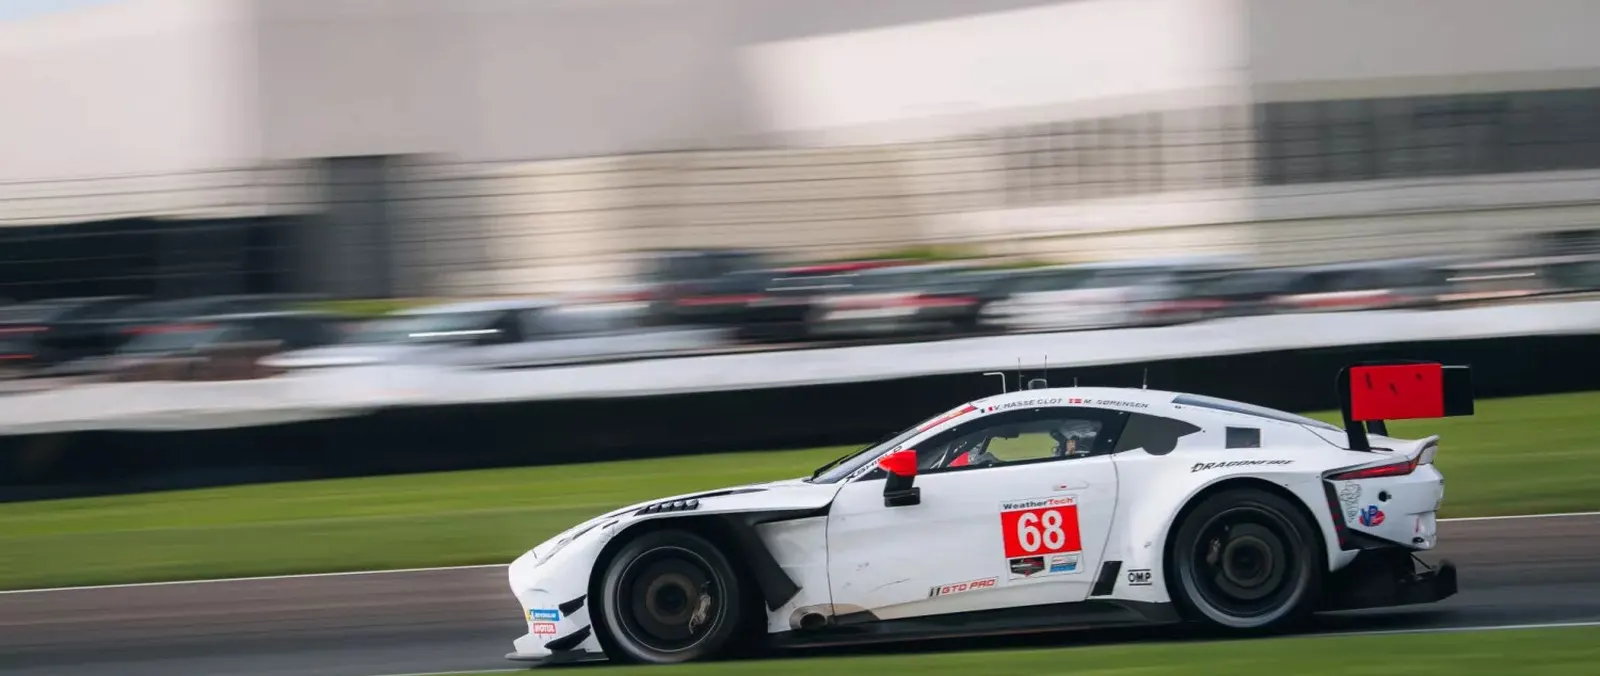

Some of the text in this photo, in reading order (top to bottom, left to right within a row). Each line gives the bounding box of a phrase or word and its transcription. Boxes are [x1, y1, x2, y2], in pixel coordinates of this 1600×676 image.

[1003, 498, 1073, 510] WeatherTech
[1017, 509, 1066, 553] 68
[1127, 572, 1152, 583] OMP
[942, 579, 996, 594] GTD PRO
